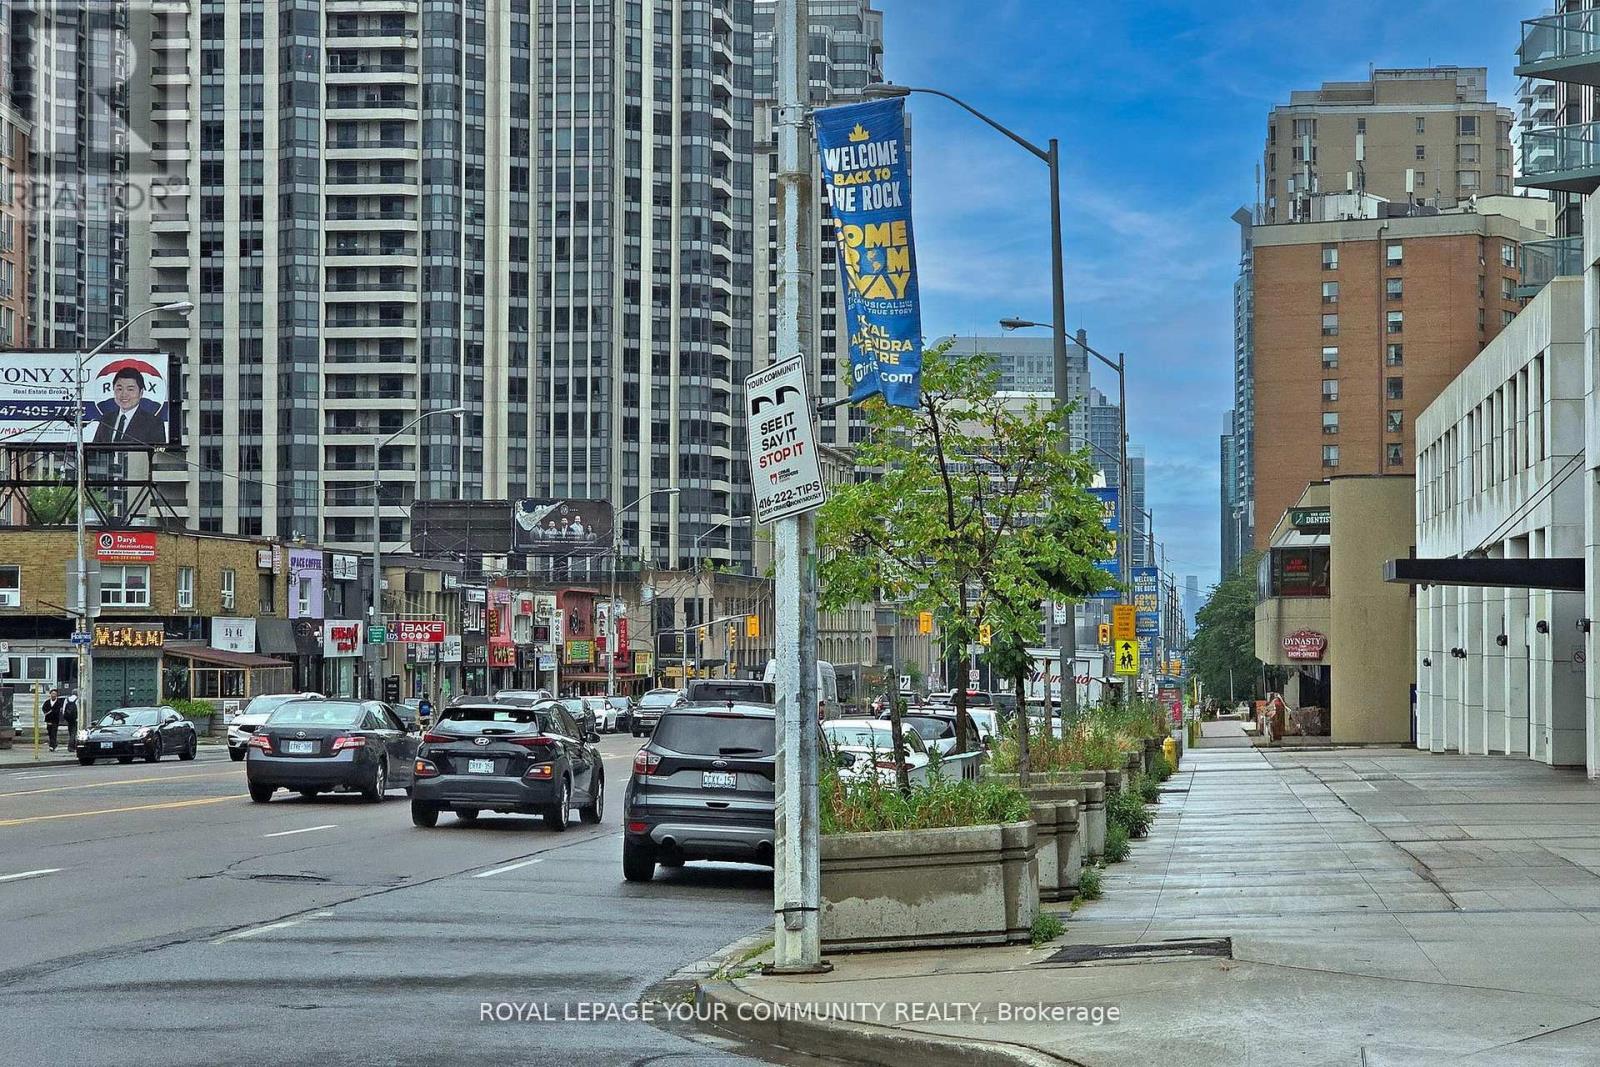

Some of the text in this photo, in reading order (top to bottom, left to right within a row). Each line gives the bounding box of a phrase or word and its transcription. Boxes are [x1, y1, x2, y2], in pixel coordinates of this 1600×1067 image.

[823, 140, 899, 172] WELCOME
[834, 168, 891, 186] BACK TO
[826, 181, 902, 212] THE ROCK
[864, 300, 897, 309] USICAL
[867, 307, 913, 315] TRUE STORY
[747, 361, 801, 390] YOUR COMMUNITY
[760, 411, 795, 435] SEE IT
[762, 427, 798, 451] SAY IT
[759, 442, 804, 468] STOP IT
[758, 480, 821, 510] 416-222-TIPS
[117, 535, 137, 544] Daryk
[1284, 637, 1321, 645] DYNASTY
